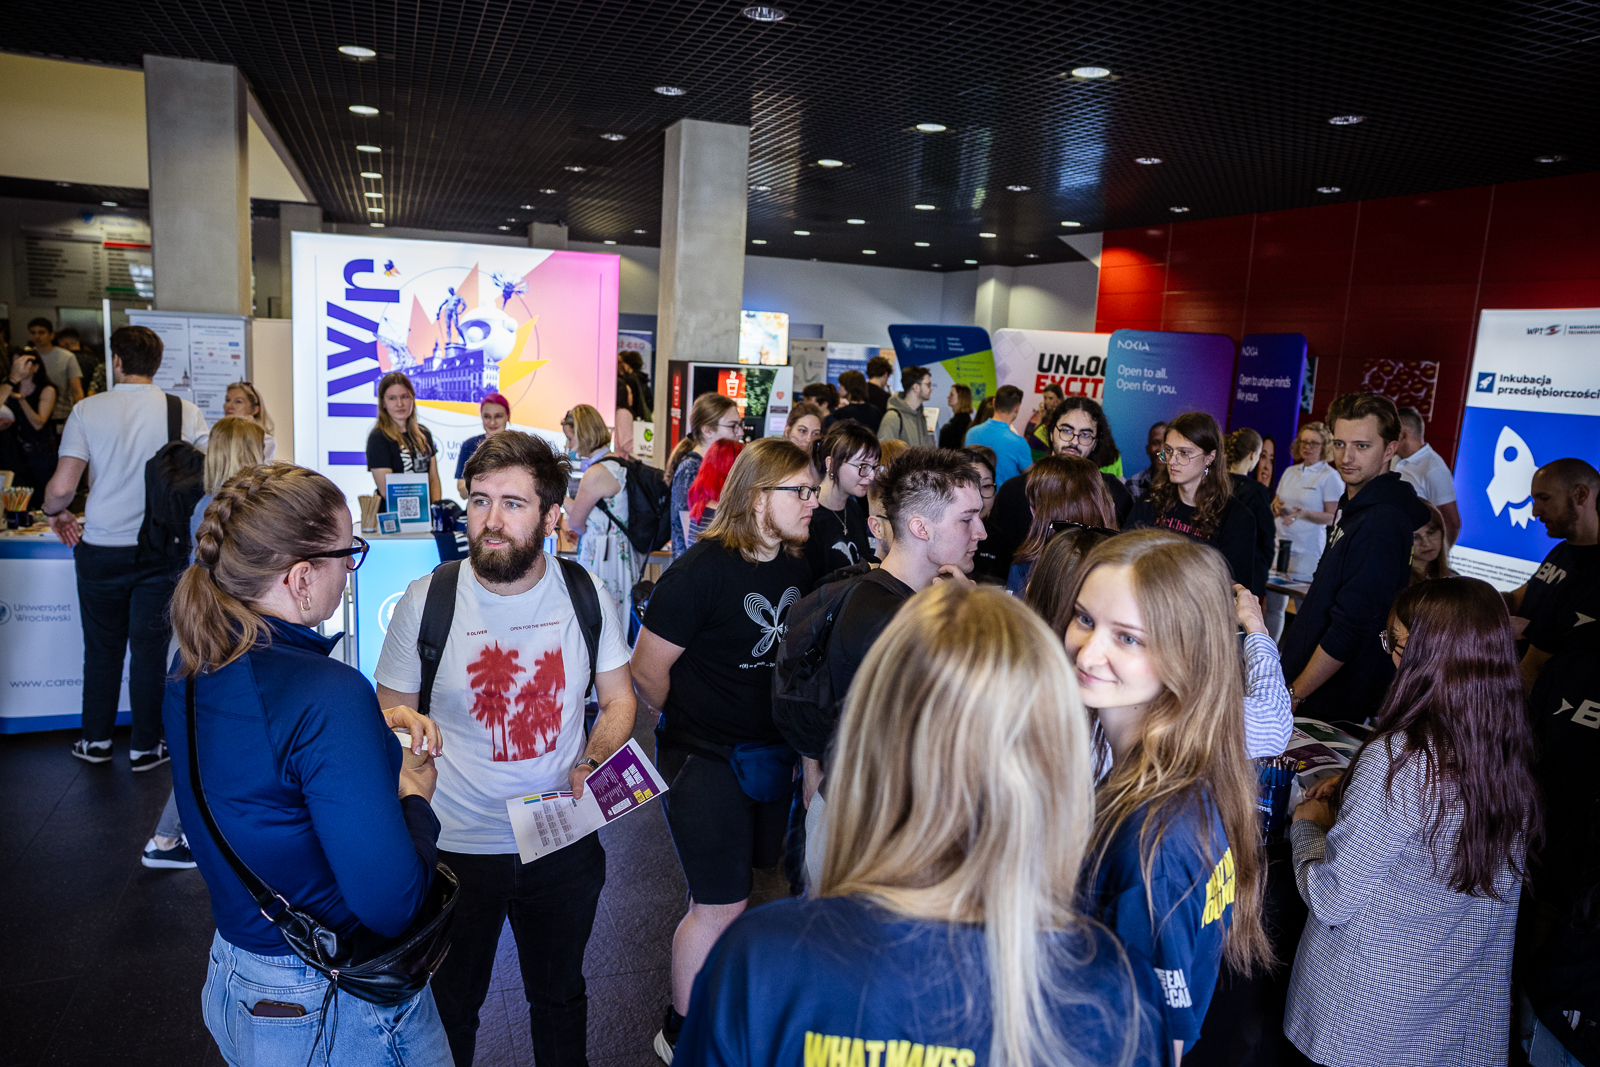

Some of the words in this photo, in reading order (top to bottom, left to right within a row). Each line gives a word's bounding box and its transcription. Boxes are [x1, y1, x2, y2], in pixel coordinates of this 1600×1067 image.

[1526, 327, 1544, 335] WPT
[1117, 340, 1149, 351] NOKIA
[1118, 364, 1142, 377] Open
[1143, 367, 1154, 378] to
[1155, 368, 1168, 379] all.
[1034, 374, 1105, 399] EXCIT
[1116, 378, 1140, 391] Open
[1142, 380, 1156, 392] for
[1157, 384, 1177, 395] you.
[1500, 374, 1552, 386] Inkubacja
[1497, 386, 1600, 399] przedsiębiorczości
[13, 603, 71, 613] Uniwersytet
[804, 1030, 885, 1067] WHAT
